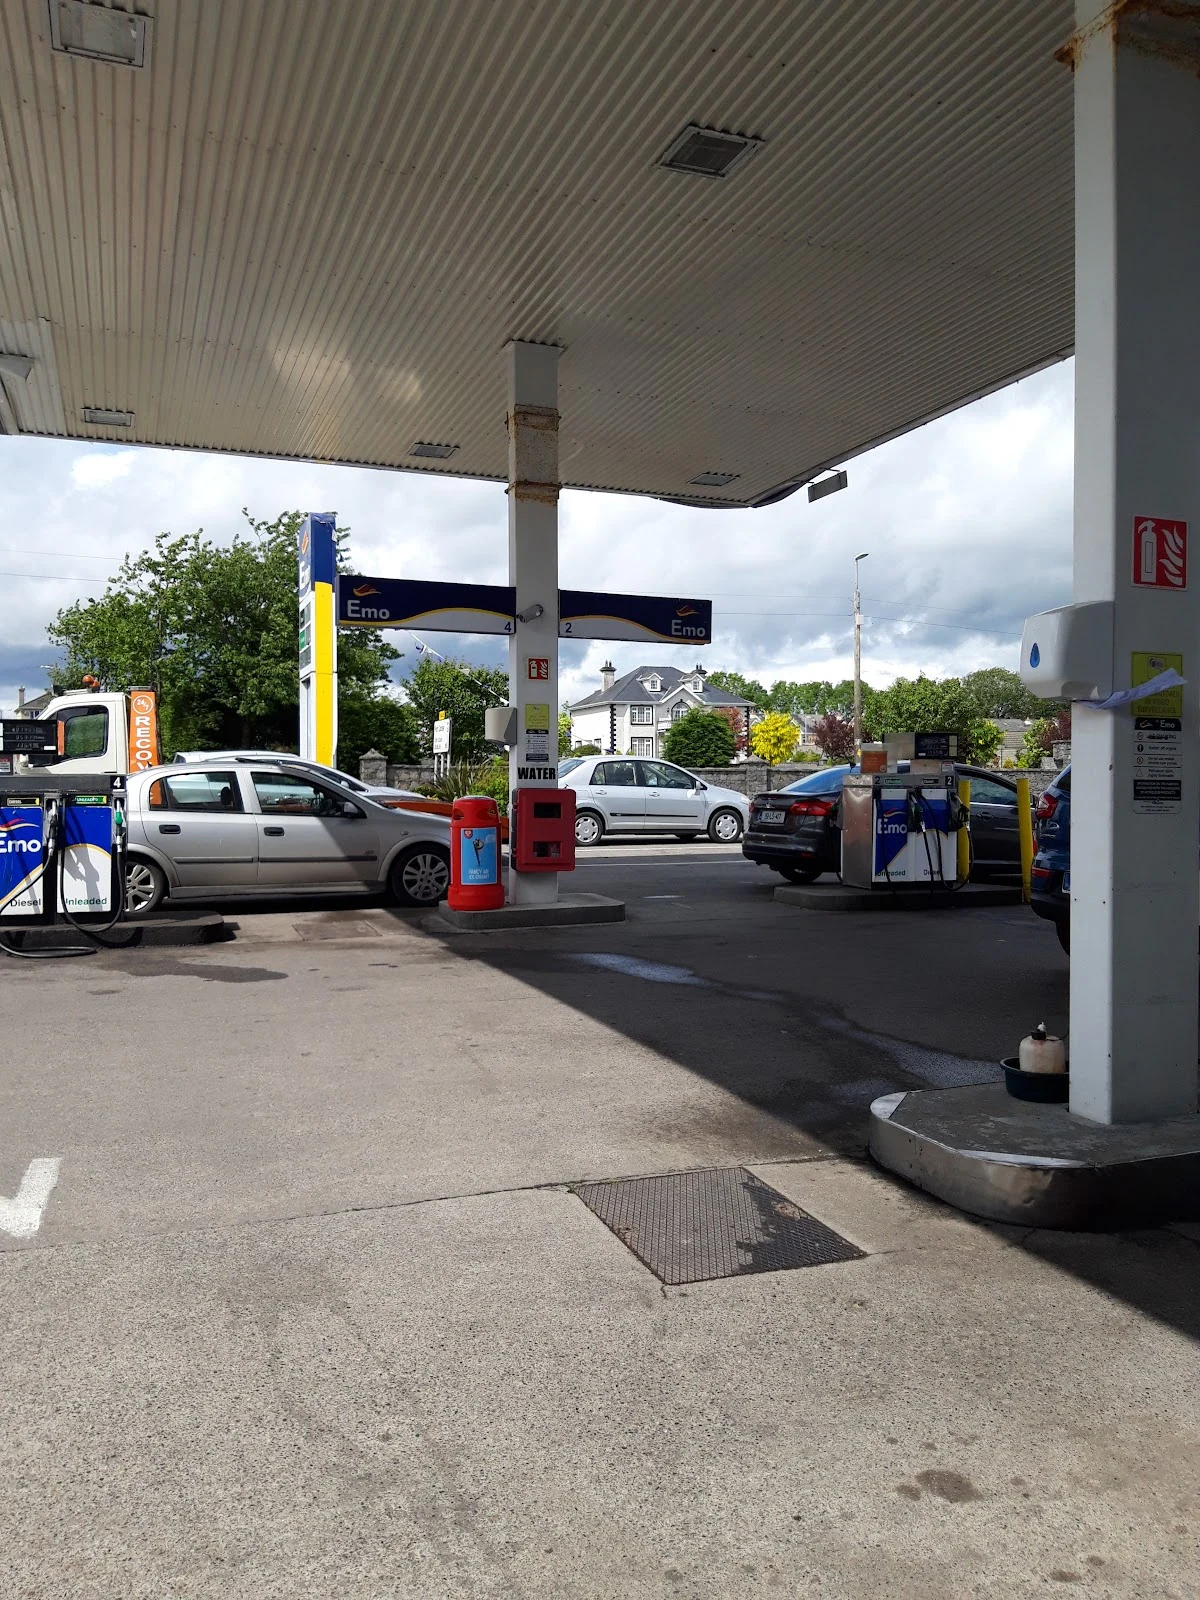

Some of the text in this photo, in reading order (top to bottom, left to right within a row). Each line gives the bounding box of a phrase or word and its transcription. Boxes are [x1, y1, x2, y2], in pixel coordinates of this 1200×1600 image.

[347, 600, 390, 619] Emo
[504, 621, 512, 632] 4
[565, 622, 572, 633] 2
[671, 619, 706, 637] Emo
[136, 699, 150, 711] 24/7
[1160, 720, 1176, 729] Emo
[517, 767, 556, 780] WATER
[113, 776, 121, 788] 4
[874, 775, 880, 785] 2
[947, 776, 952, 785] 2
[876, 818, 908, 834] Emo
[10, 898, 41, 907] Diesel
[64, 897, 107, 906] nleaded
